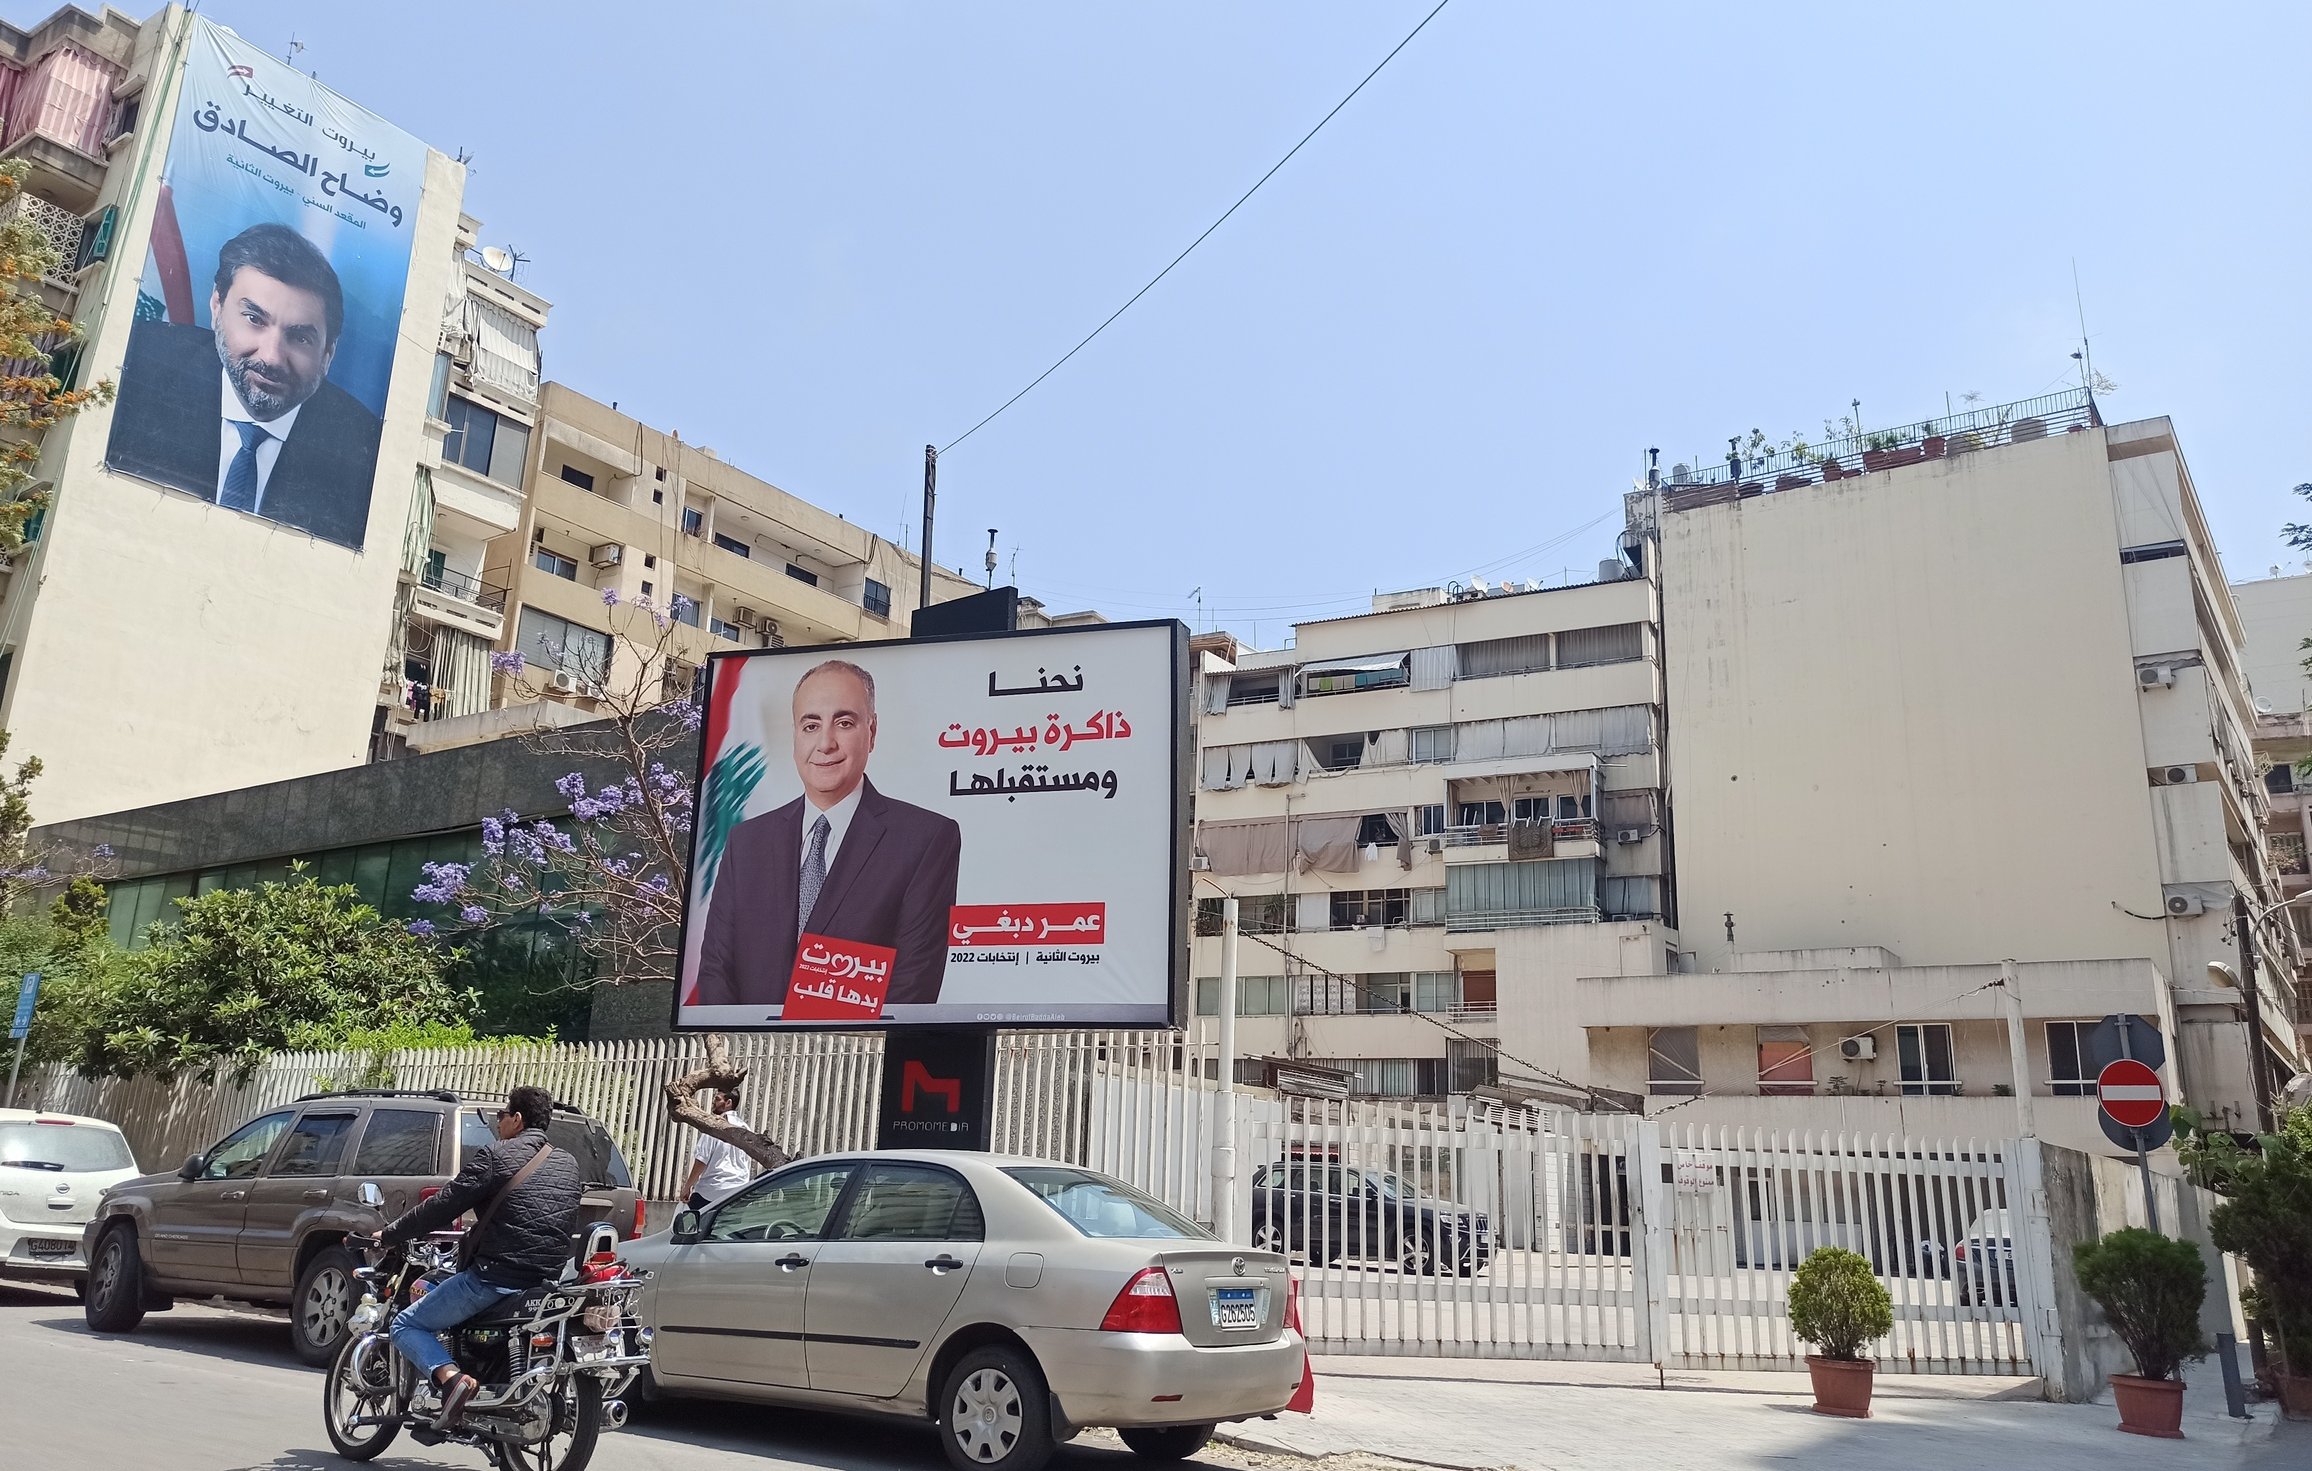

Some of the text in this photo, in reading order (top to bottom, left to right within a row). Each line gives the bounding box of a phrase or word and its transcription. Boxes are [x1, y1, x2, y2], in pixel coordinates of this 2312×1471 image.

[242, 84, 376, 162] بيروت التغيير
[193, 100, 403, 228] وضاح الصادق
[226, 153, 262, 178] الثانية
[262, 174, 294, 196] بيروت
[302, 194, 333, 214] السني
[334, 209, 366, 230] المقعد
[988, 664, 1084, 697] نحنا
[938, 709, 1132, 756] ذاكرة بيروت
[949, 764, 1118, 803] ومستقبلها
[952, 909, 1101, 945] عمر دبغي
[950, 952, 975, 963] 2022
[977, 951, 1020, 966] إنتخابات
[1036, 949, 1066, 965] الثانية
[1067, 951, 1100, 965] بيروت
[793, 978, 879, 1014] بدها قلب
[893, 1121, 969, 1132] PROMOMEDIA
[1221, 1304, 1256, 1323] G262505
